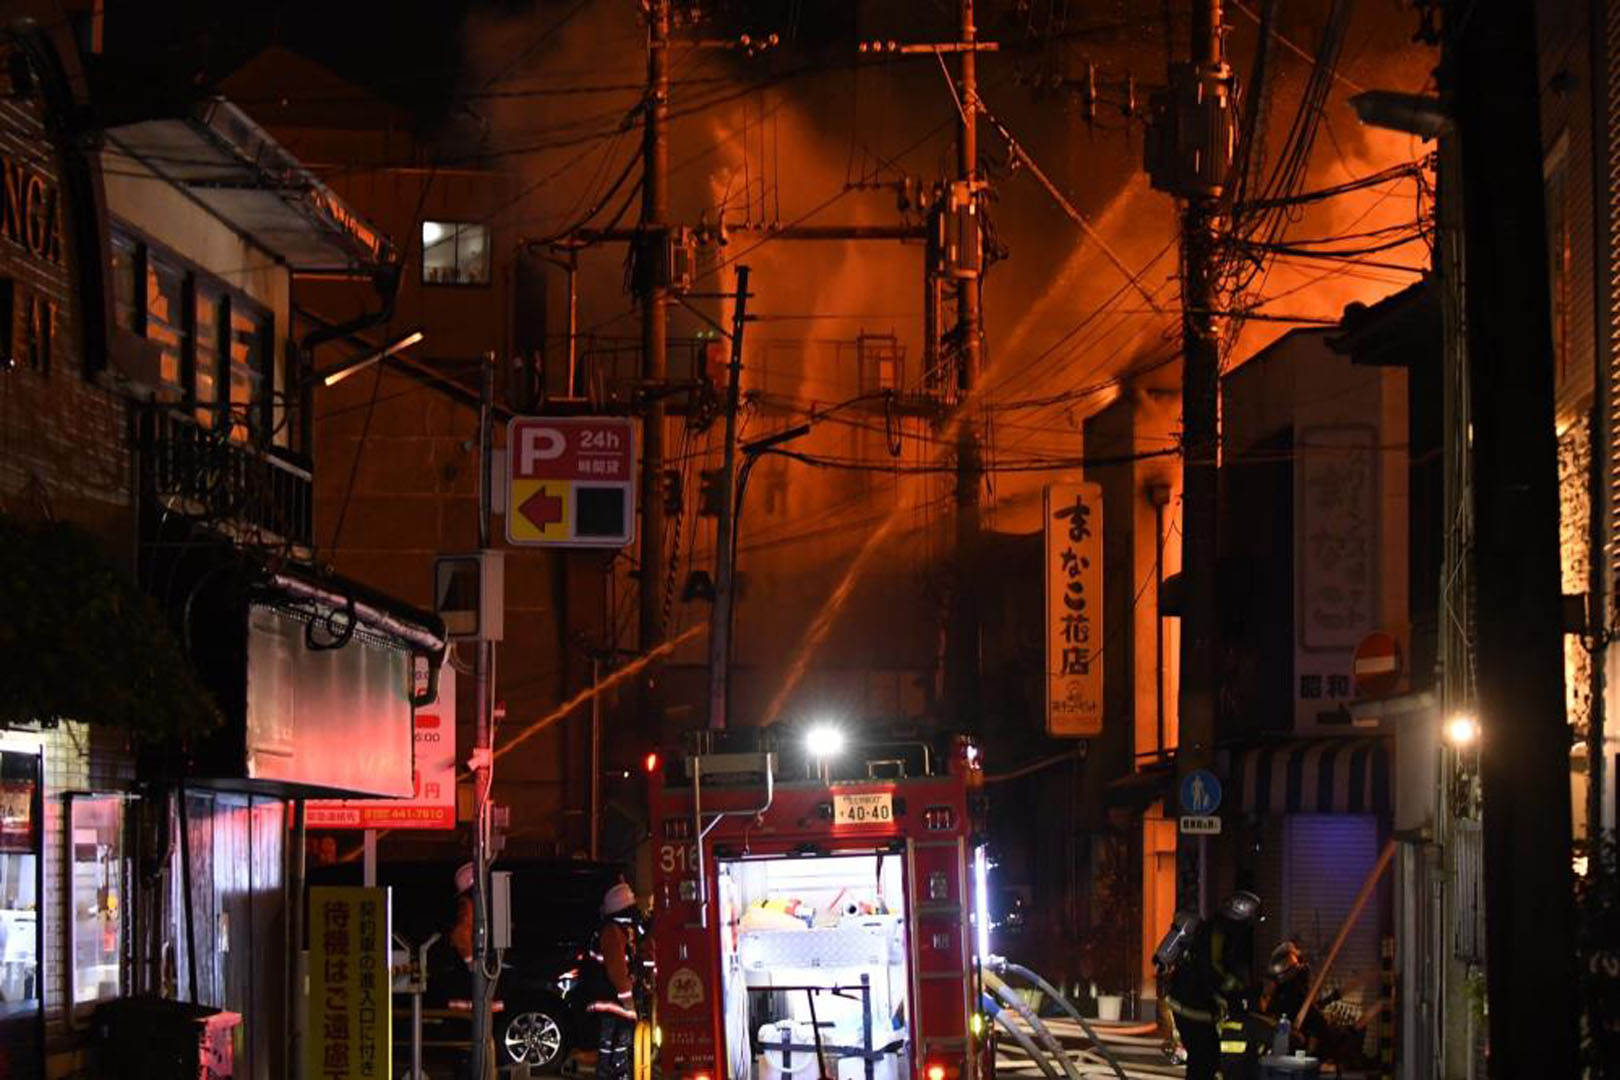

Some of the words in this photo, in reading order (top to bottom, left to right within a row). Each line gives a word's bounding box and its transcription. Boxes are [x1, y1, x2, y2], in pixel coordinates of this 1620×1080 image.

[520, 427, 567, 475] P
[580, 430, 619, 448] 24h
[578, 458, 619, 473] 時間貸
[1053, 495, 1091, 676] まなこ花店
[1301, 674, 1362, 698] 昭和
[660, 845, 698, 873] 316
